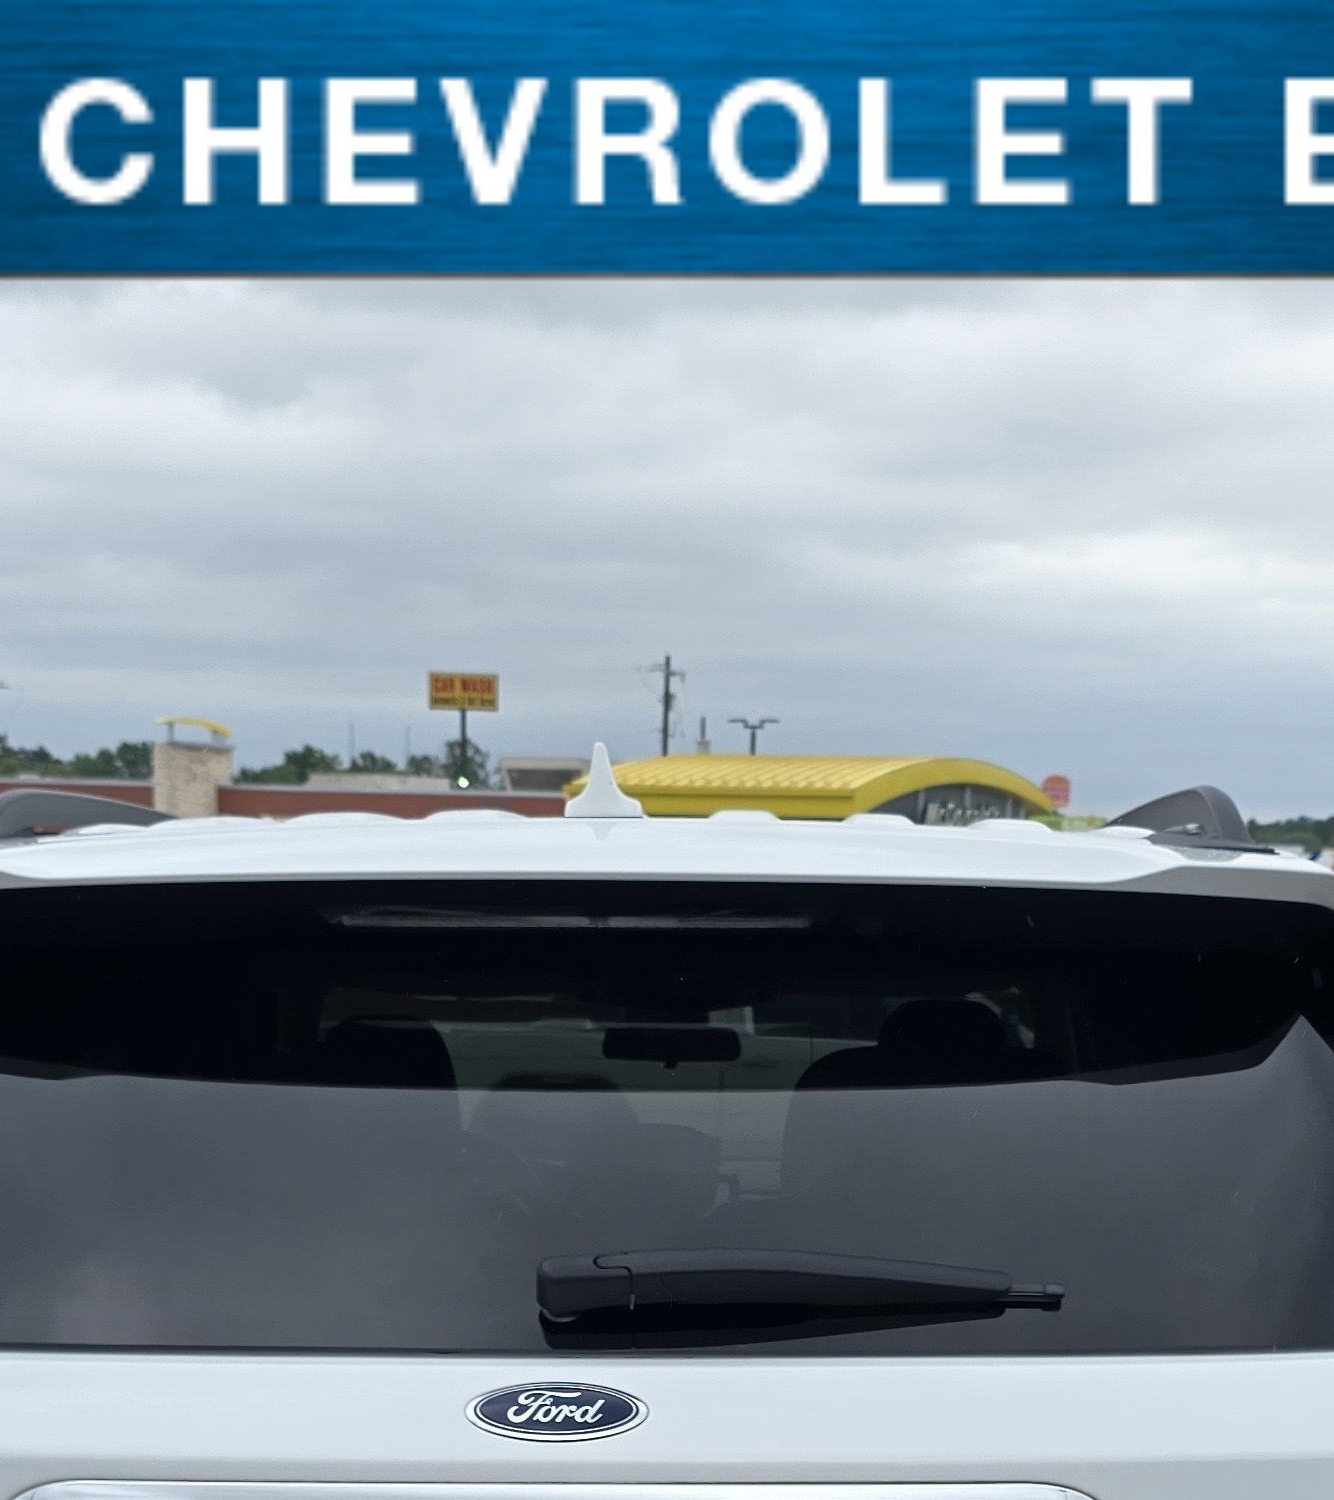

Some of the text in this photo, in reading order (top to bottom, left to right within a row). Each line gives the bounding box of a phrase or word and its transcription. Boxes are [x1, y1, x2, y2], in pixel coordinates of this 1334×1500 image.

[433, 677, 493, 695] CAR WASH
[506, 1389, 606, 1424] Ford
